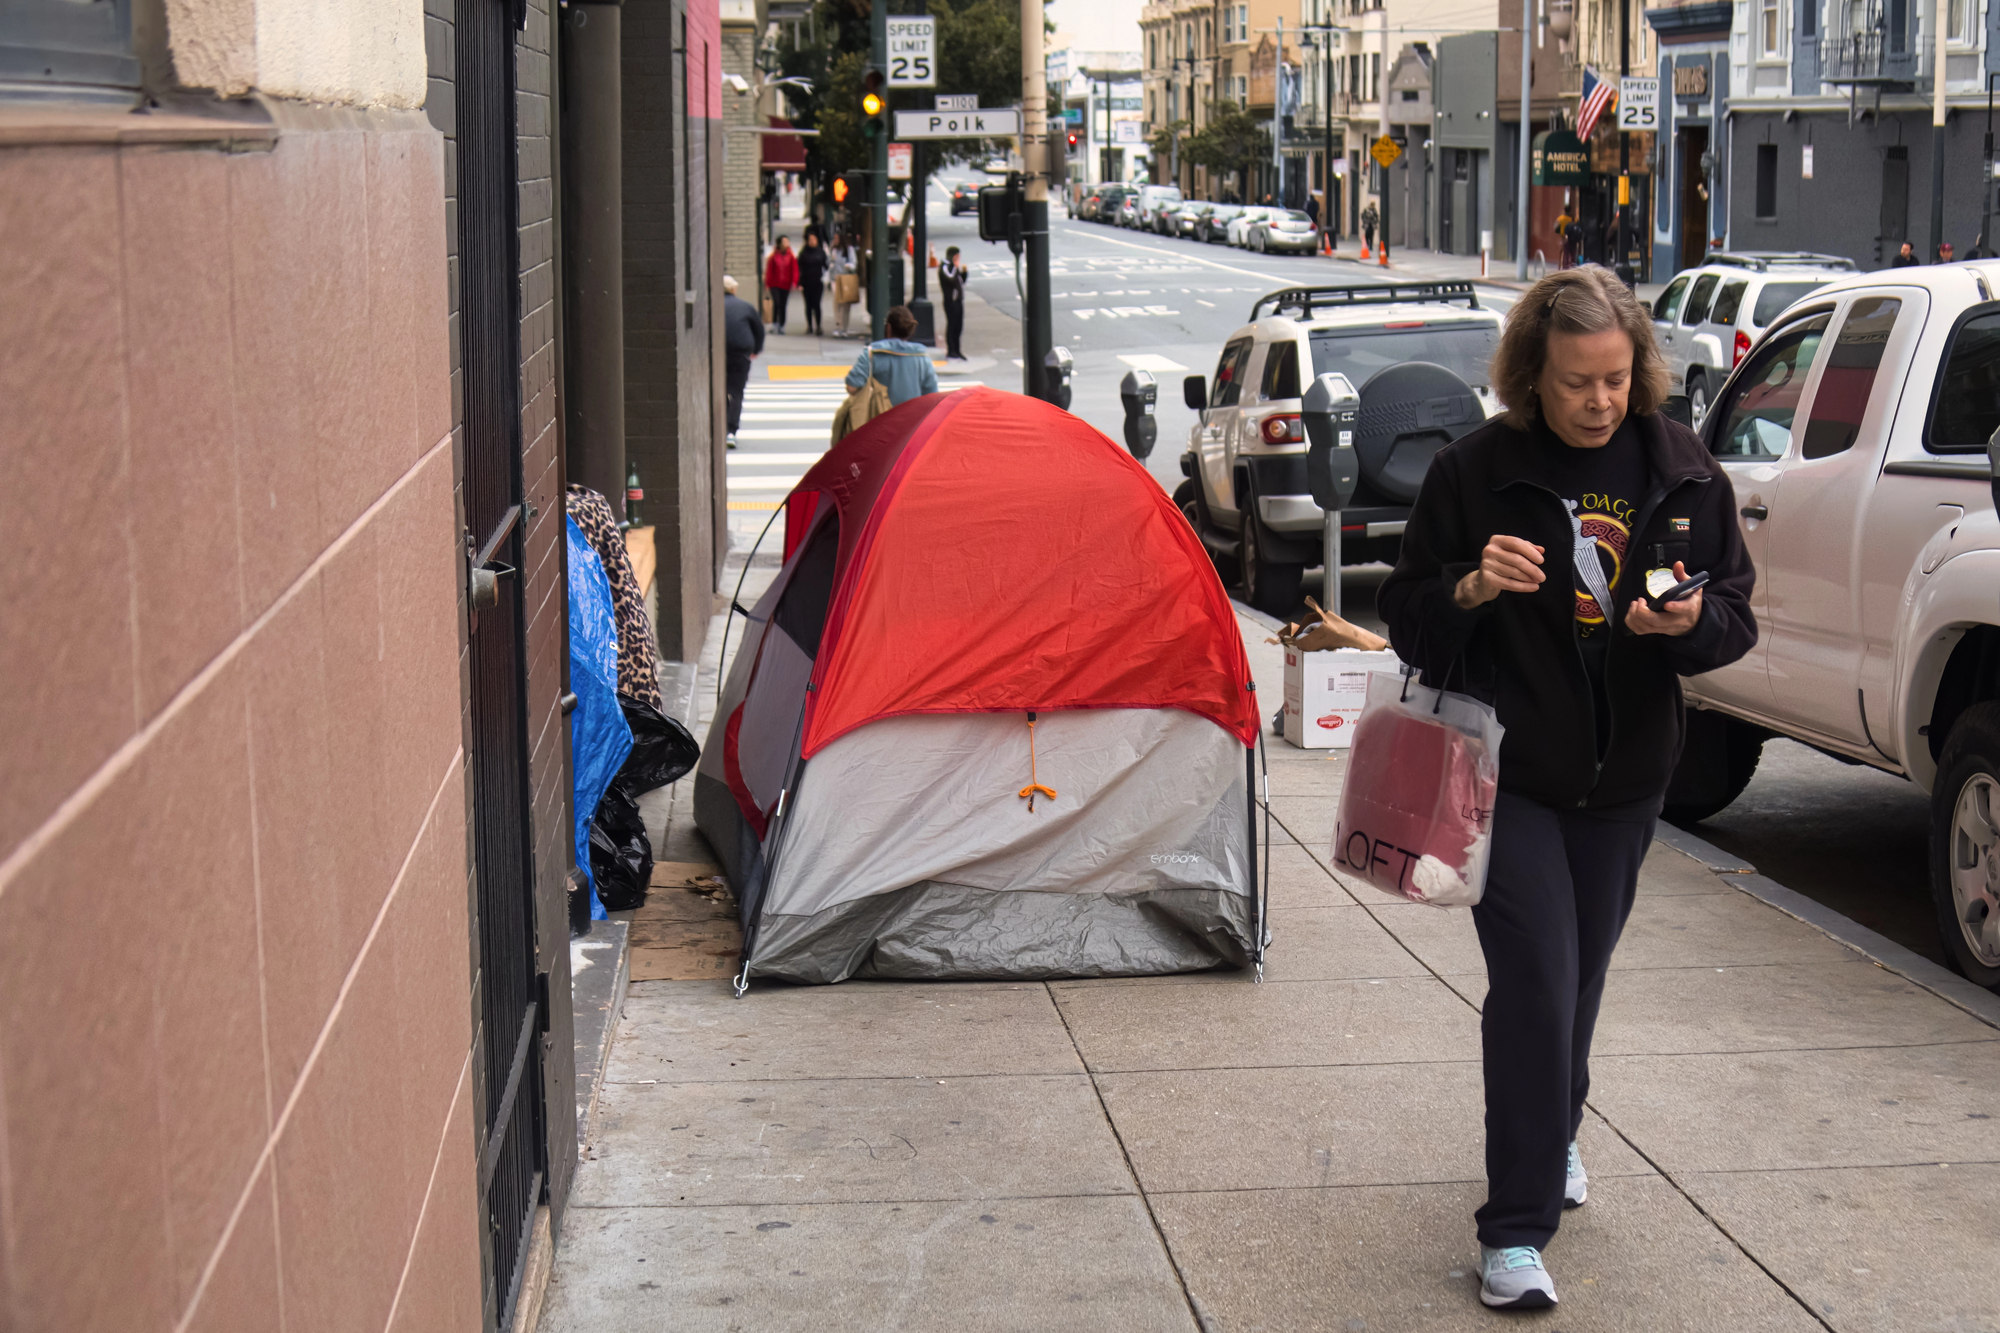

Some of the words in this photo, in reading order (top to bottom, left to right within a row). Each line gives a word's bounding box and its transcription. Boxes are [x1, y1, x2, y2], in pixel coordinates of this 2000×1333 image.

[889, 24, 932, 36] SPEED
[892, 41, 928, 52] LIMIT
[891, 57, 930, 80] 25
[1623, 81, 1657, 91] SPEED
[1626, 93, 1653, 103] LIMIT
[1624, 106, 1655, 125] 25
[929, 116, 985, 132] Polk
[1547, 152, 1587, 163] AMERICA
[1553, 162, 1581, 172] HOTEL
[1072, 305, 1180, 319] FIRE
[1336, 821, 1422, 891] LOFT
